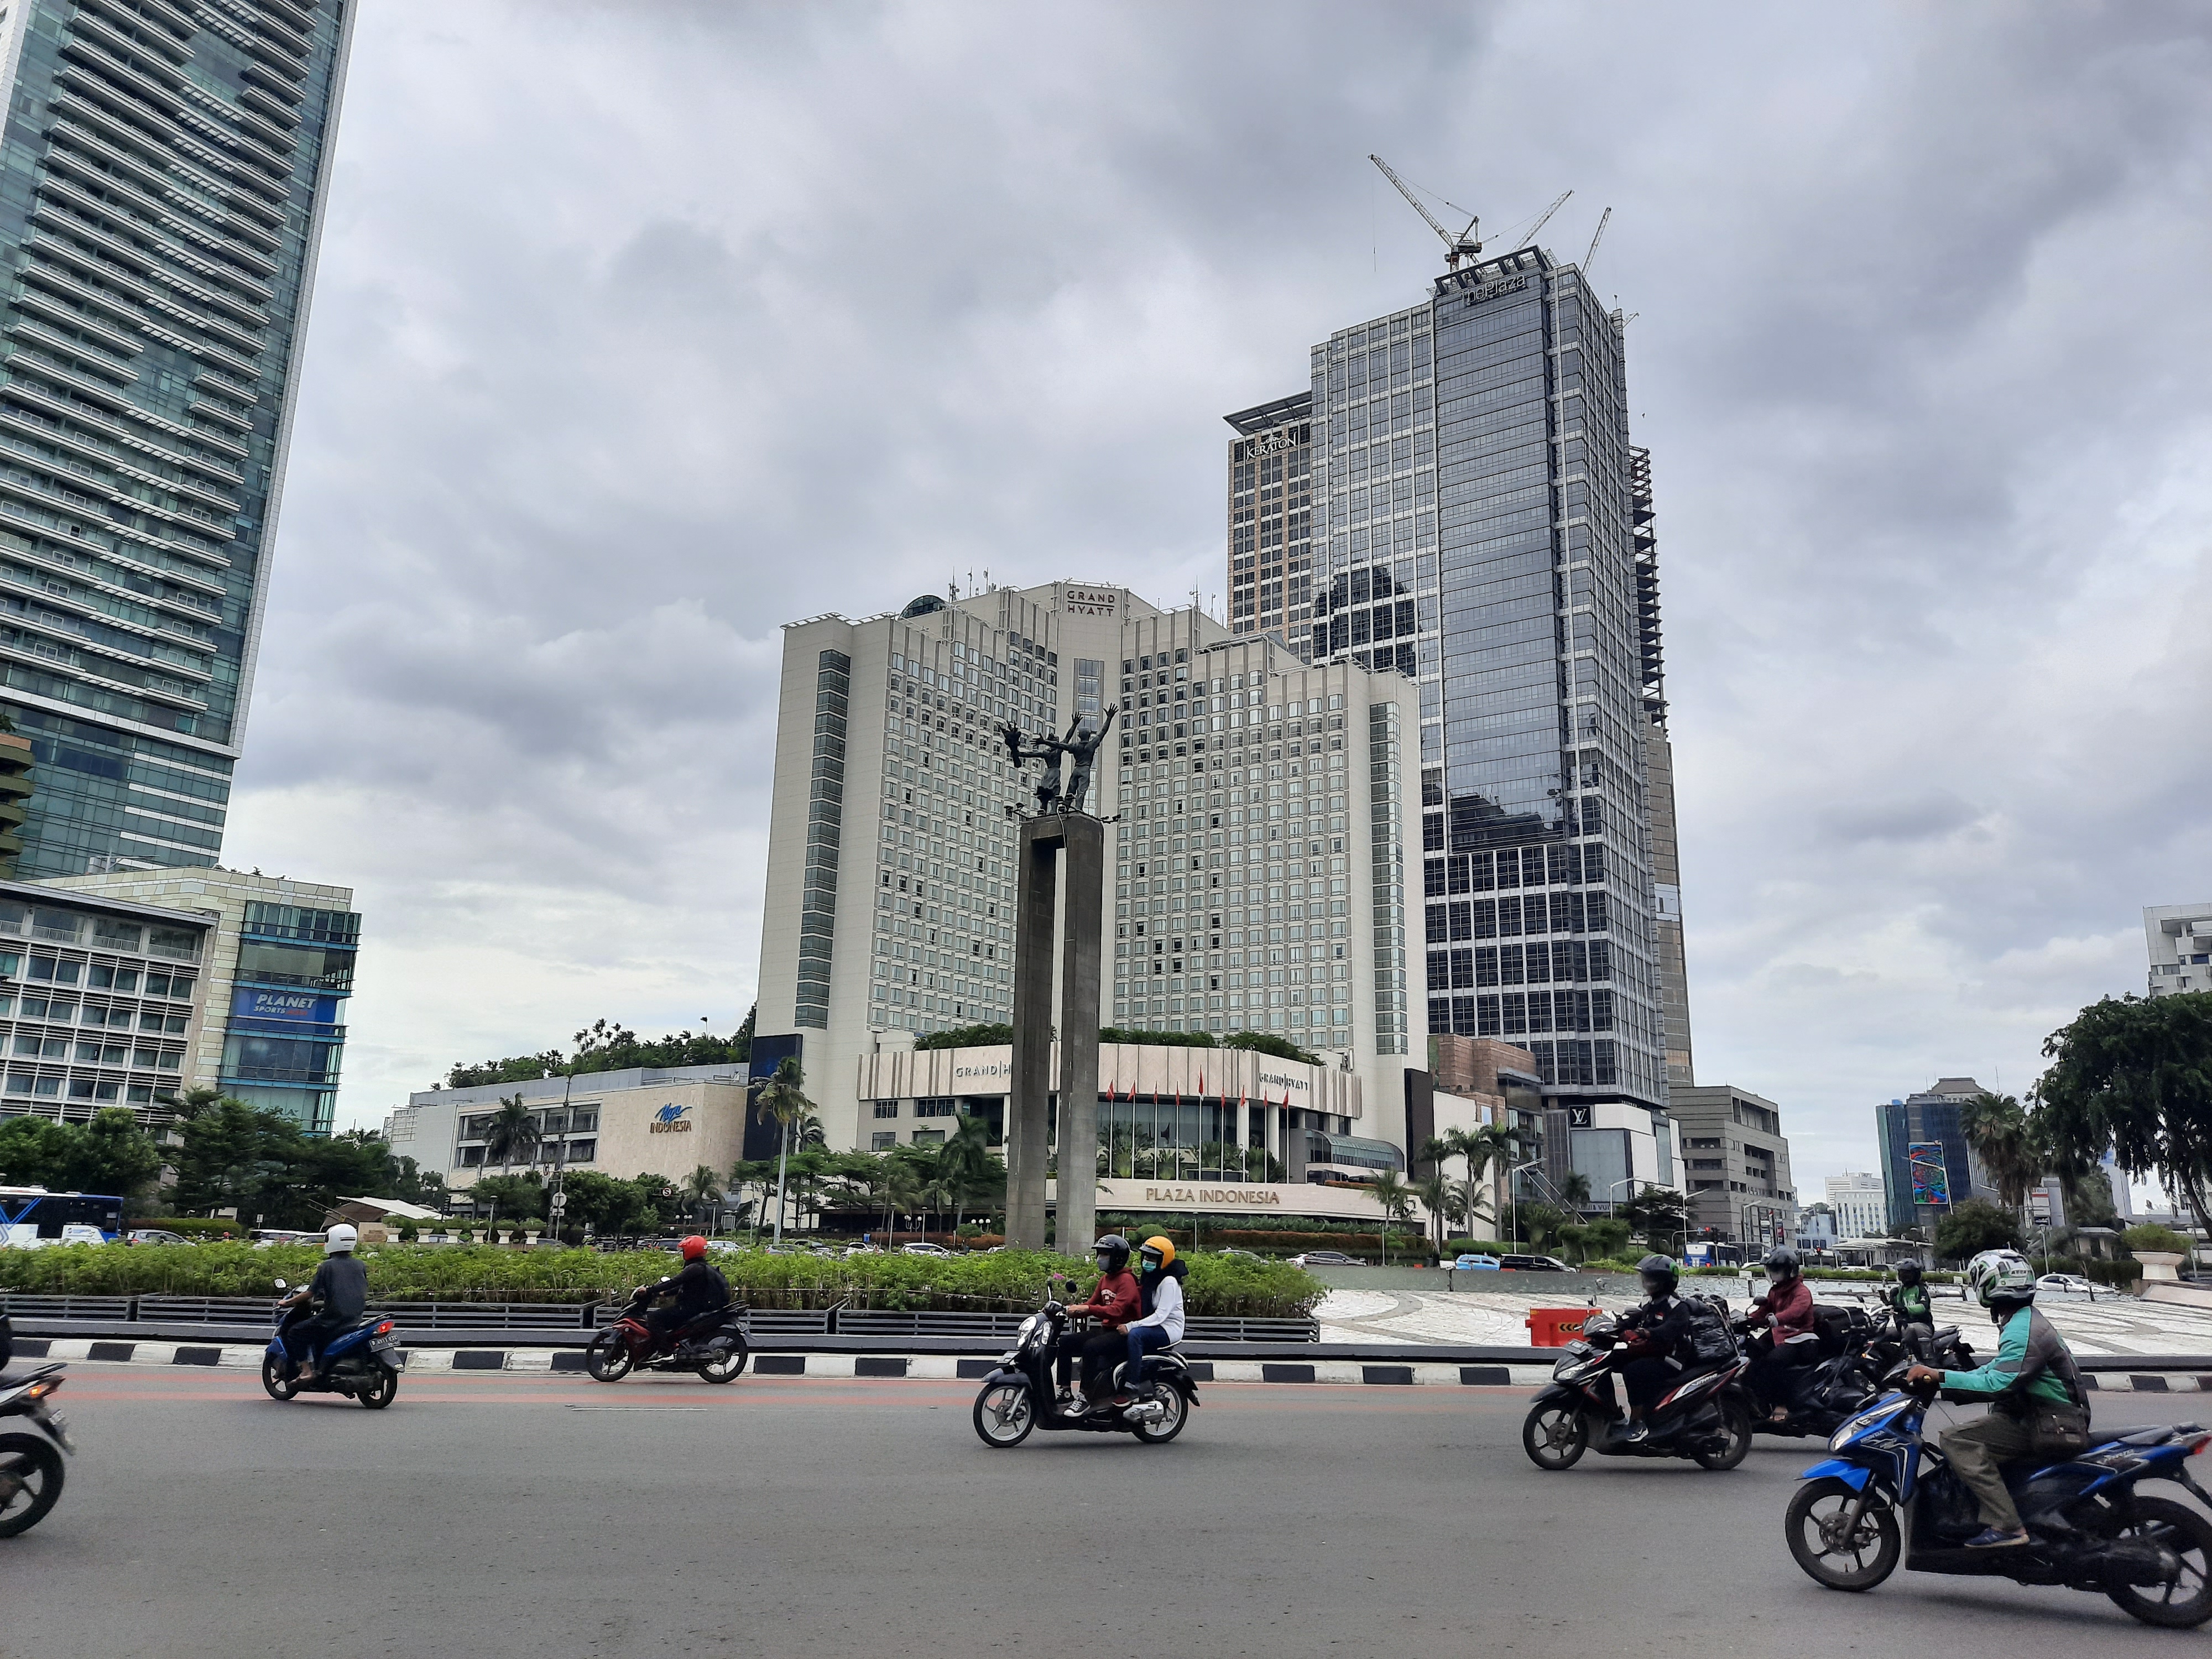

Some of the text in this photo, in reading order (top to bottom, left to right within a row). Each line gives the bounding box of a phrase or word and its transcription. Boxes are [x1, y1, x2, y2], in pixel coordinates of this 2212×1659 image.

[1246, 431, 1298, 461] KERATON
[1067, 590, 1115, 603] GRAND
[1067, 604, 1114, 617] HYATT
[256, 994, 317, 1009] PLANET
[253, 1005, 286, 1014] SPORTS
[955, 1065, 998, 1078] GRAND
[1259, 1072, 1308, 1091] GRAND HYATT
[649, 1120, 692, 1134] INDONESIA
[1145, 1187, 1280, 1204] PLAZA INDONESIA
